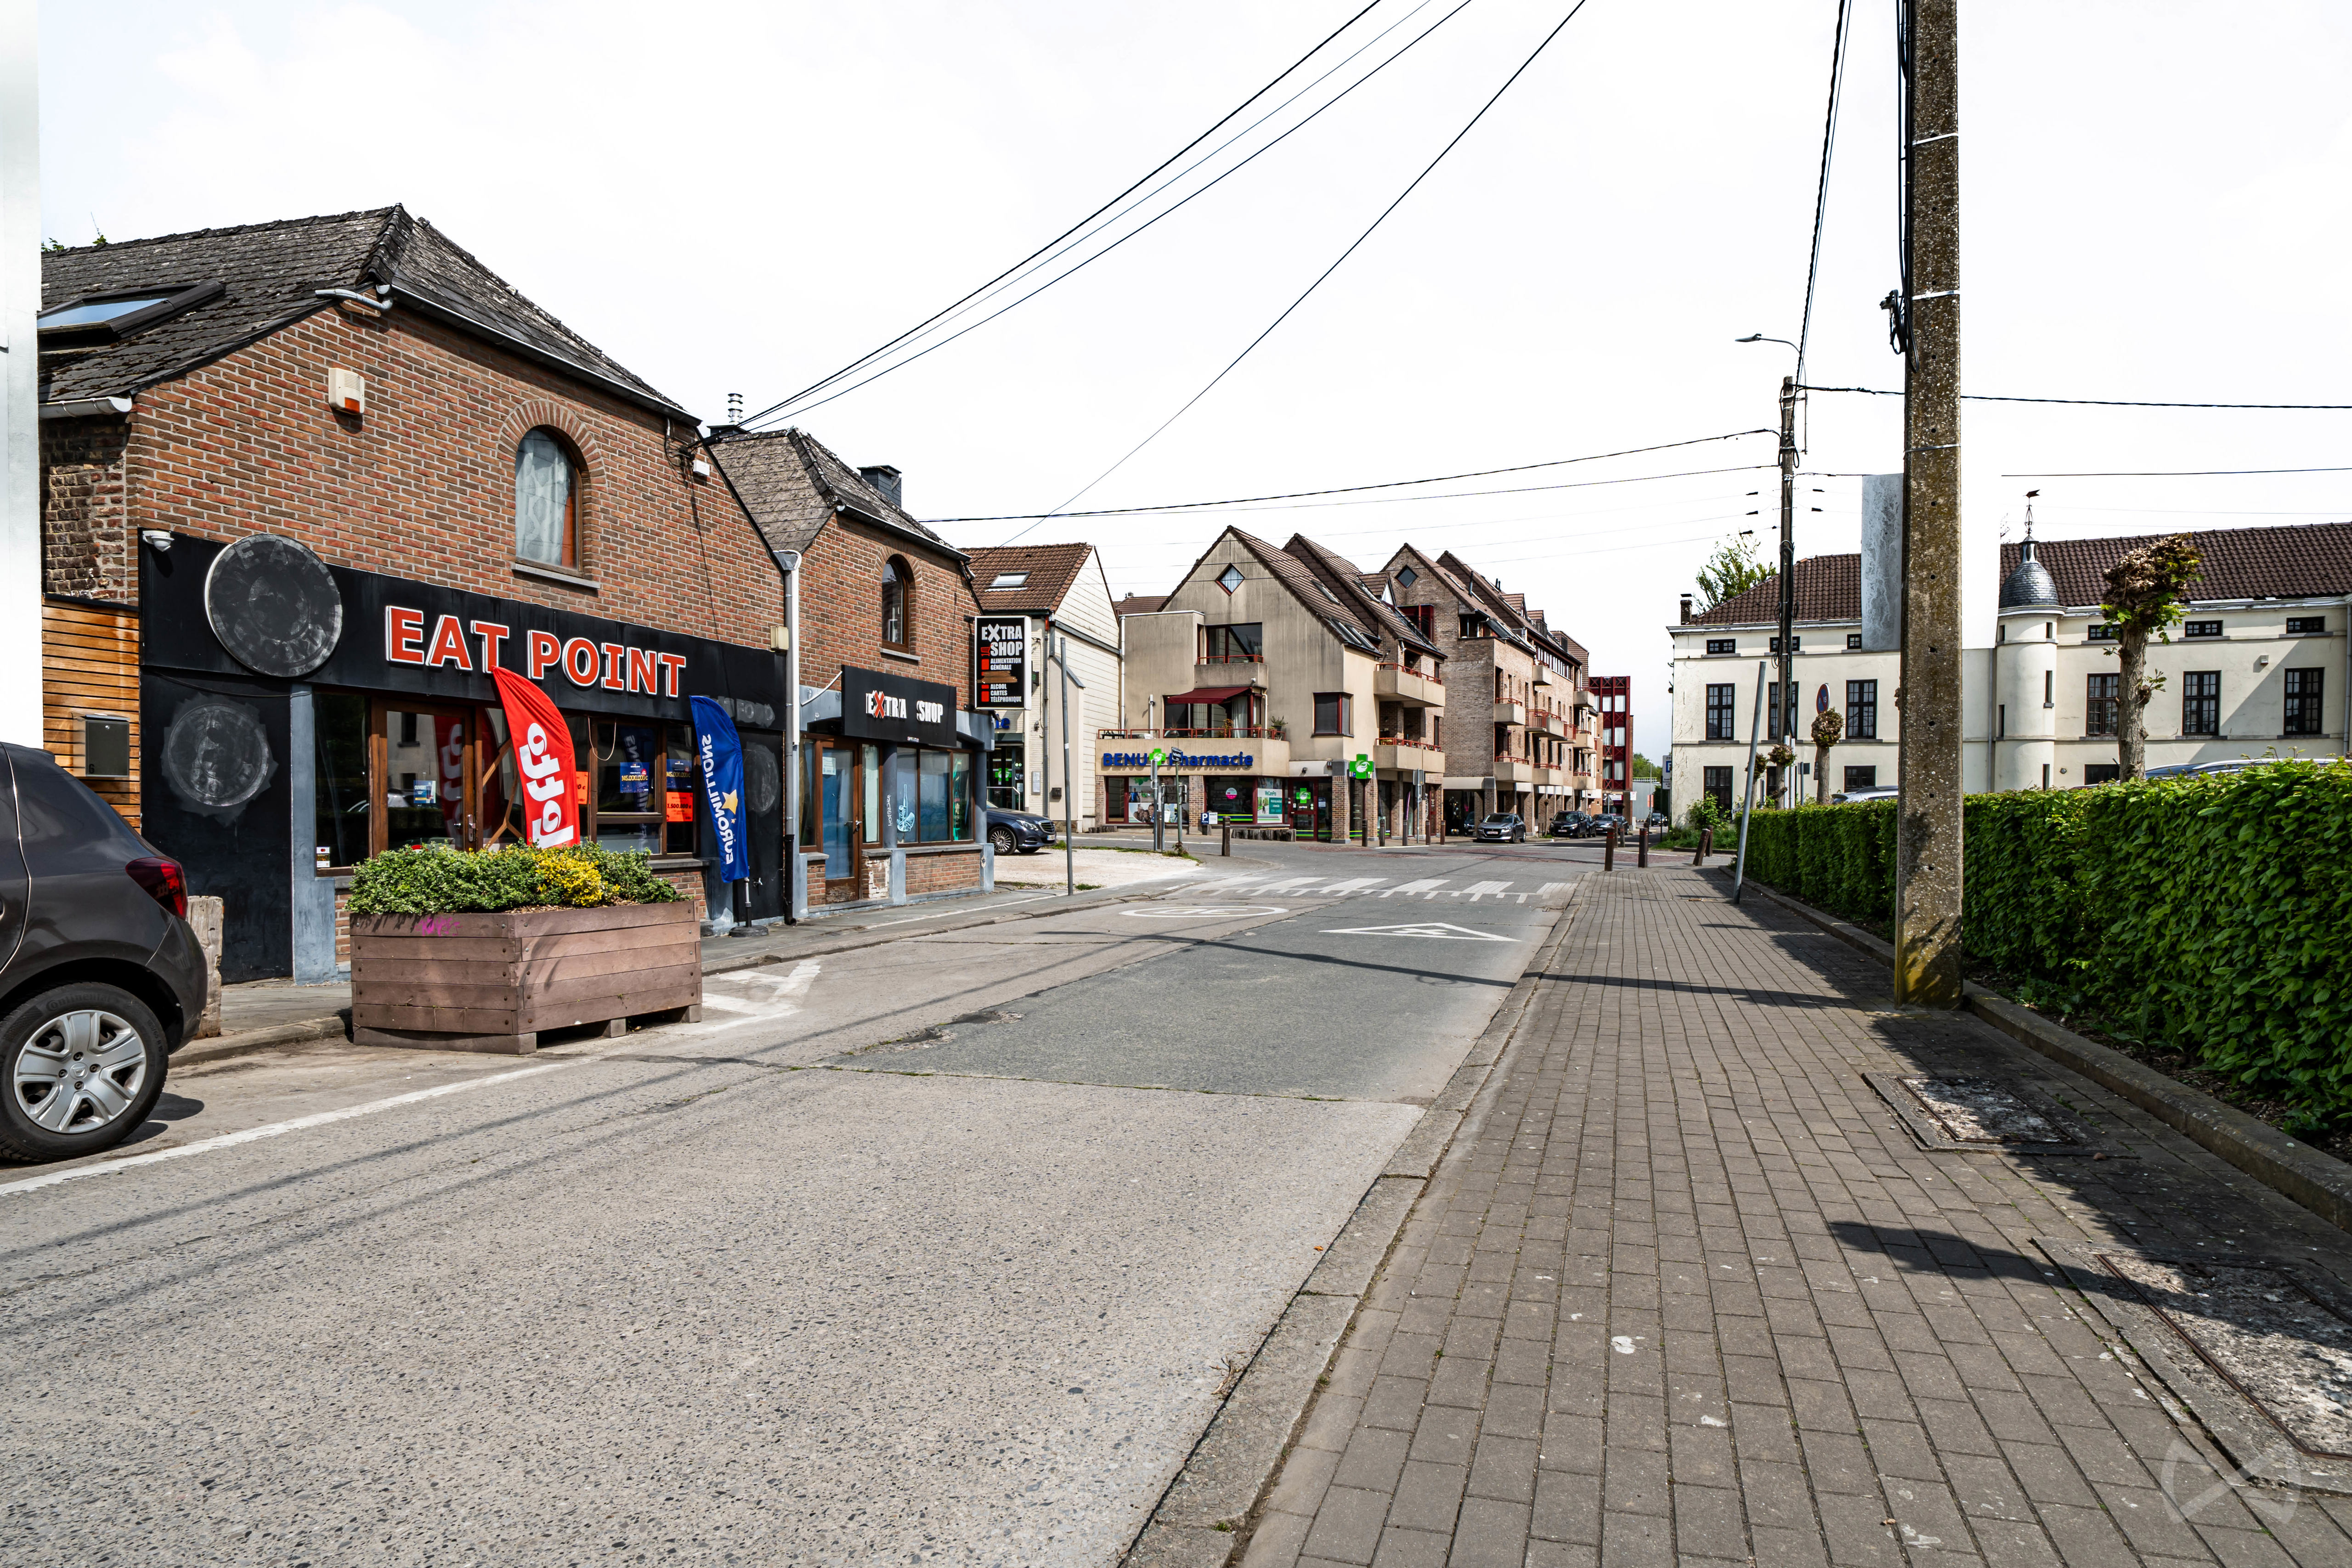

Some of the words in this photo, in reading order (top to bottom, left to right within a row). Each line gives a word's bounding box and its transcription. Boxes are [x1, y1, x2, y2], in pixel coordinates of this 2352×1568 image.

[981, 624, 1023, 642] EXTRA
[385, 605, 510, 673] EAT
[527, 630, 686, 698] POINT
[990, 641, 1023, 657] SHOP
[865, 690, 907, 719] EXTRA
[916, 700, 943, 723] SHOP
[1103, 753, 1148, 766] BENU
[88, 763, 95, 774] 6
